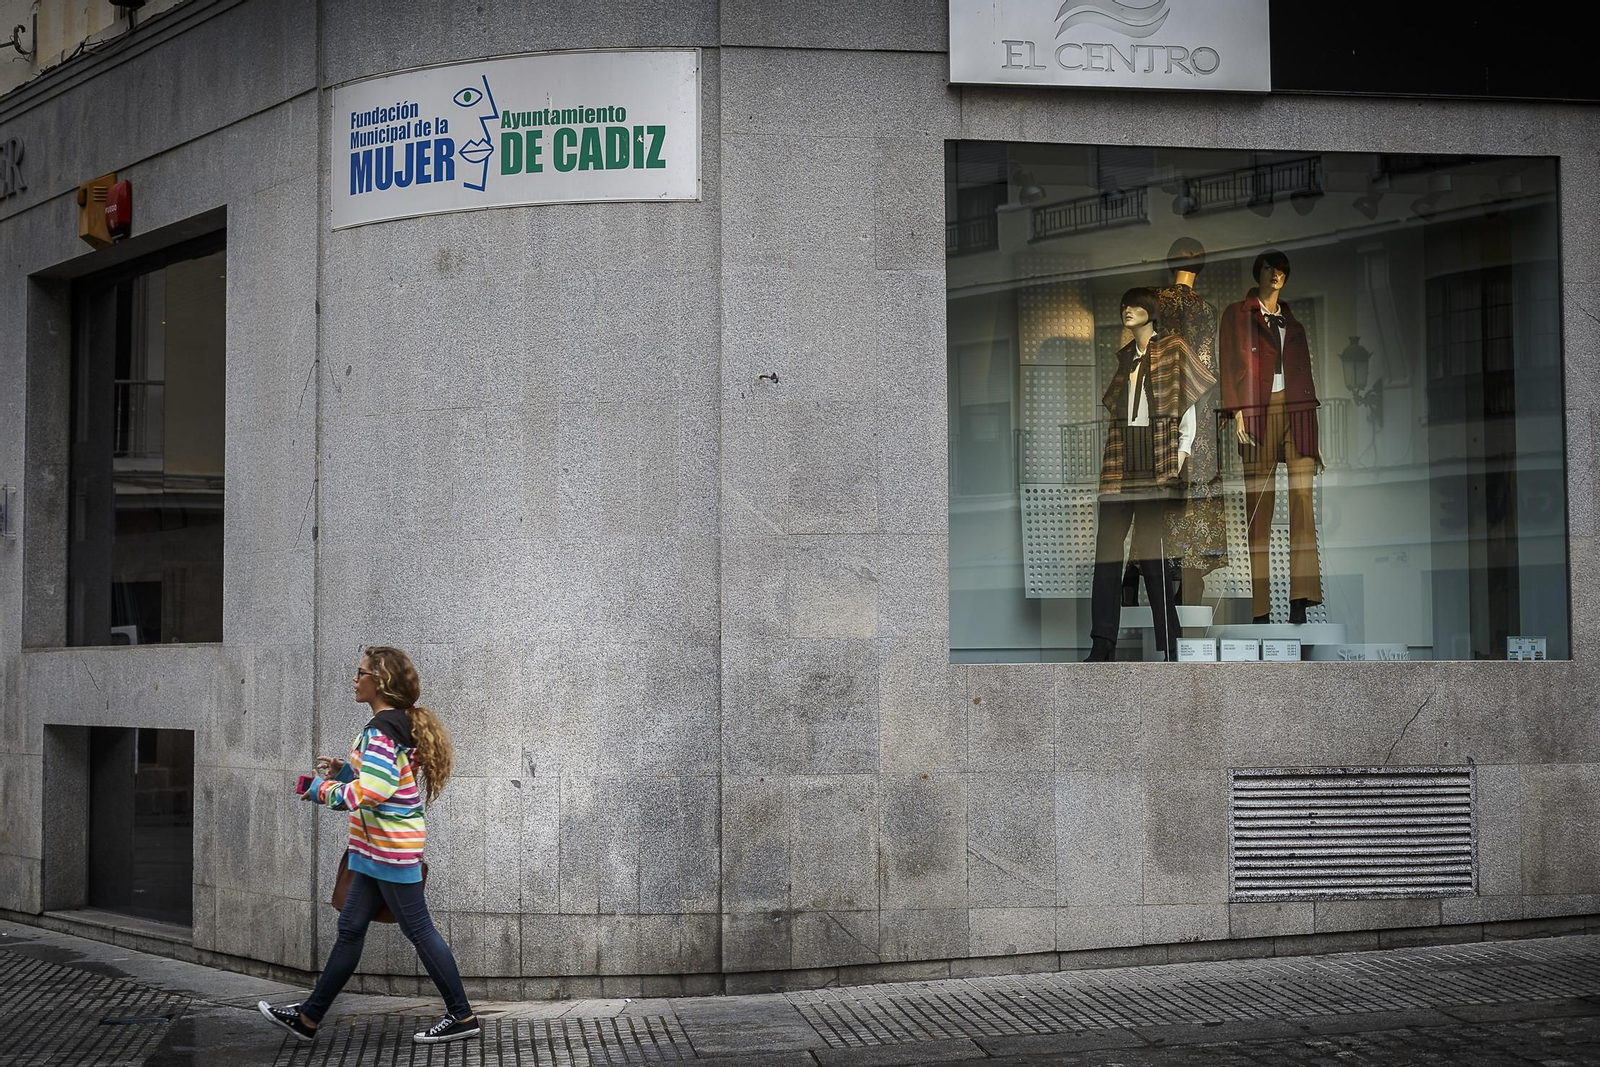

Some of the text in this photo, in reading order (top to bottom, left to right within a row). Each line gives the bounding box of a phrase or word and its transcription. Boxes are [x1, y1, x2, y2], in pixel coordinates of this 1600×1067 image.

[1001, 40, 1221, 75] EL CENTRO
[350, 100, 419, 130] Fundación
[501, 105, 627, 130] Ayuntamiento
[350, 117, 449, 149] Municipal de la
[350, 137, 455, 196] MUJER
[501, 125, 666, 176] DE CADIZ
